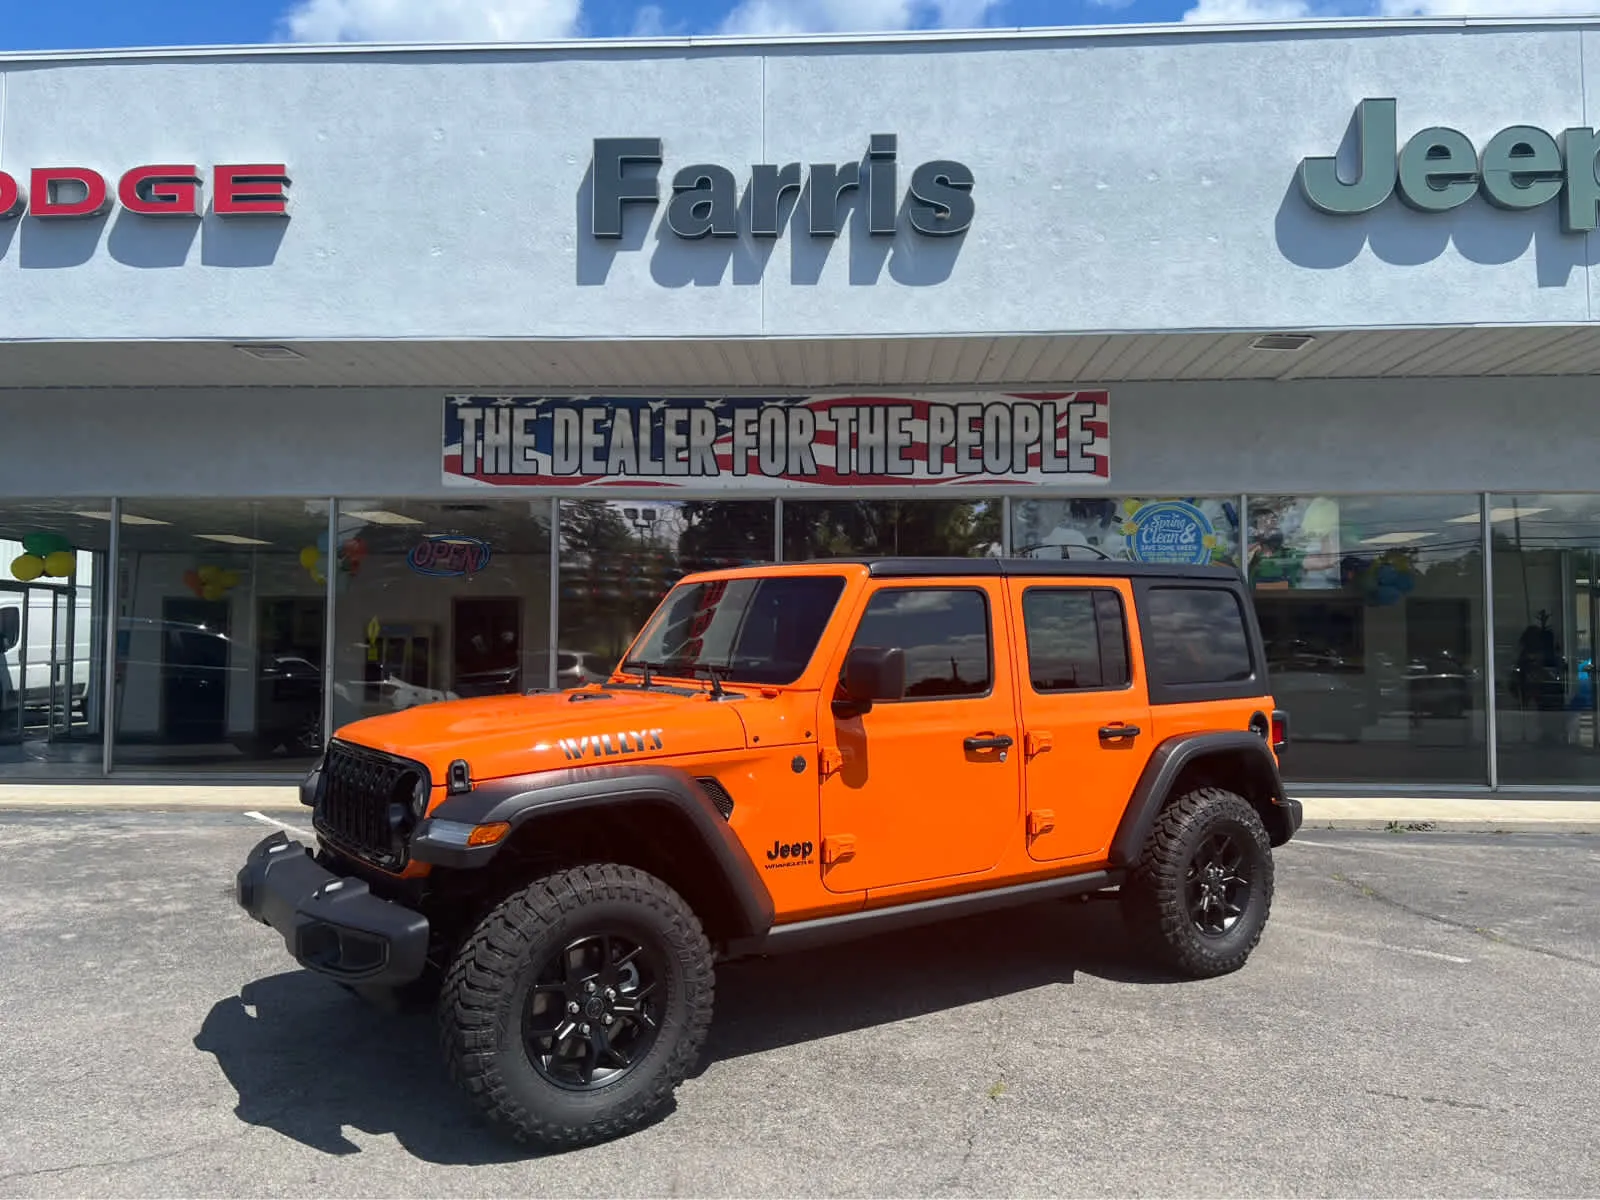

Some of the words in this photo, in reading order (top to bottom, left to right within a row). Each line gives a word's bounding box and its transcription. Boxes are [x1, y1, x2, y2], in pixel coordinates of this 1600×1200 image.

[0, 164, 290, 217] DGE
[592, 133, 976, 239] Farris
[456, 407, 540, 476] THE
[550, 406, 721, 477] DEALER
[732, 404, 817, 477] FOR
[829, 403, 914, 476] THE
[927, 401, 1097, 475] PEOPLE
[1141, 525, 1179, 544] Clean
[1180, 522, 1197, 544] &
[1151, 514, 1186, 532] Spring
[414, 541, 480, 573] OPEN
[558, 728, 663, 760] WILLYS
[767, 840, 813, 861] Jeep
